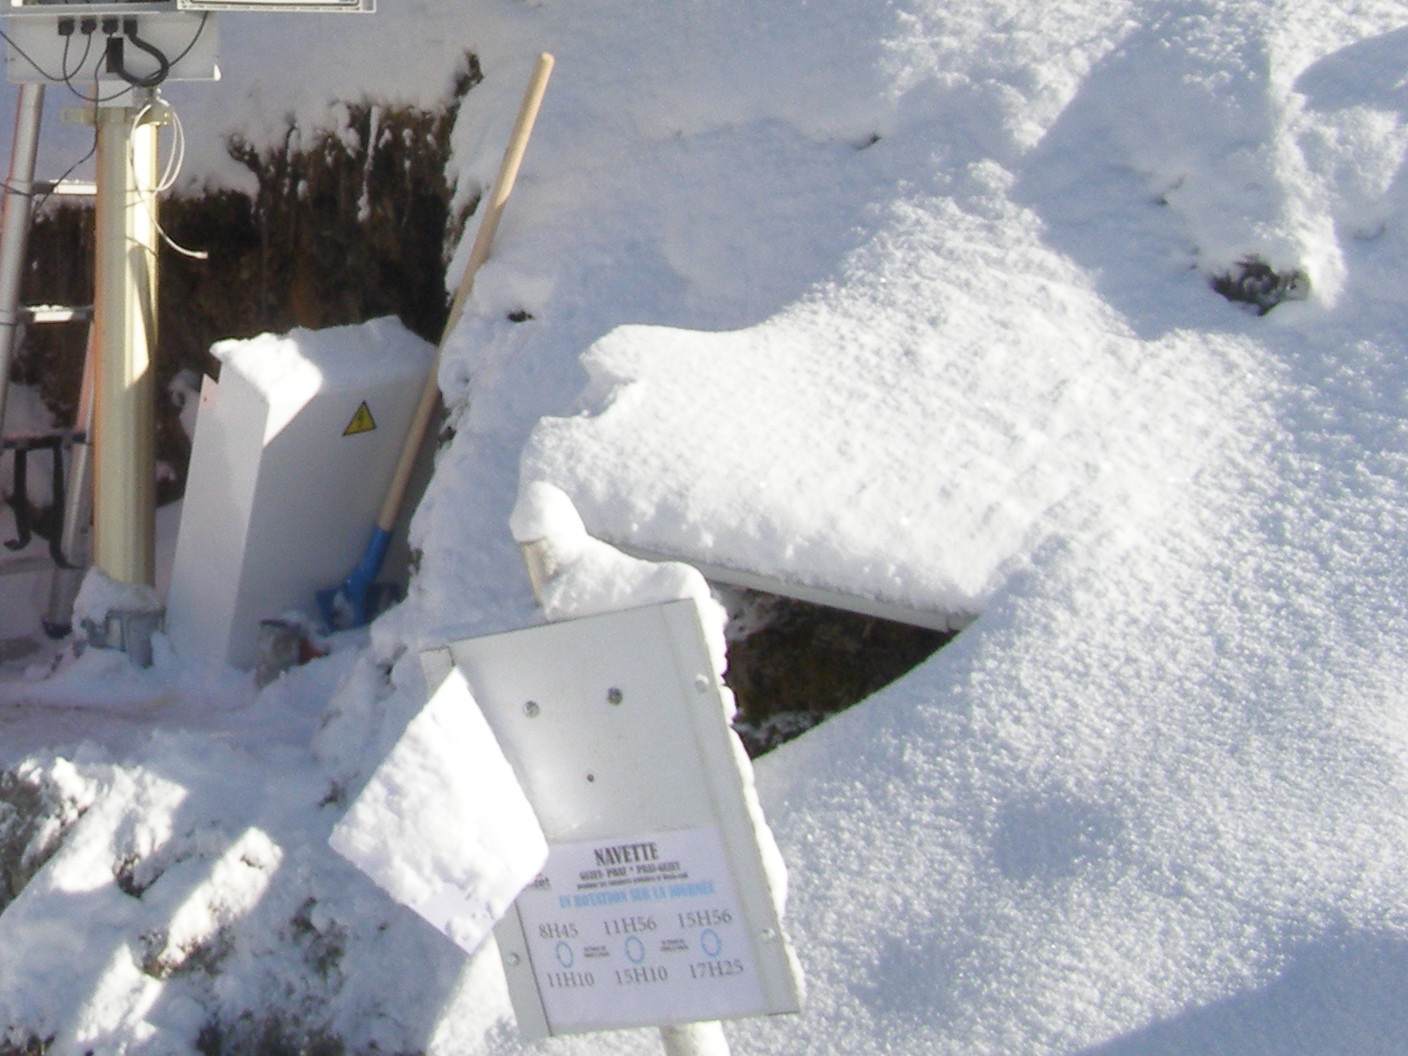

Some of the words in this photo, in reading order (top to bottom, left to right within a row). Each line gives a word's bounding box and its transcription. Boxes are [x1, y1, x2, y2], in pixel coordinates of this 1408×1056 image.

[594, 842, 659, 866] NAVETTE
[574, 891, 627, 907] ROTATION
[538, 922, 579, 939] 8H45
[603, 914, 658, 936] 11H56
[677, 908, 733, 929] 15H56
[547, 971, 595, 988] 11H10
[615, 965, 669, 986] 15H10
[688, 958, 745, 979] 17H25
